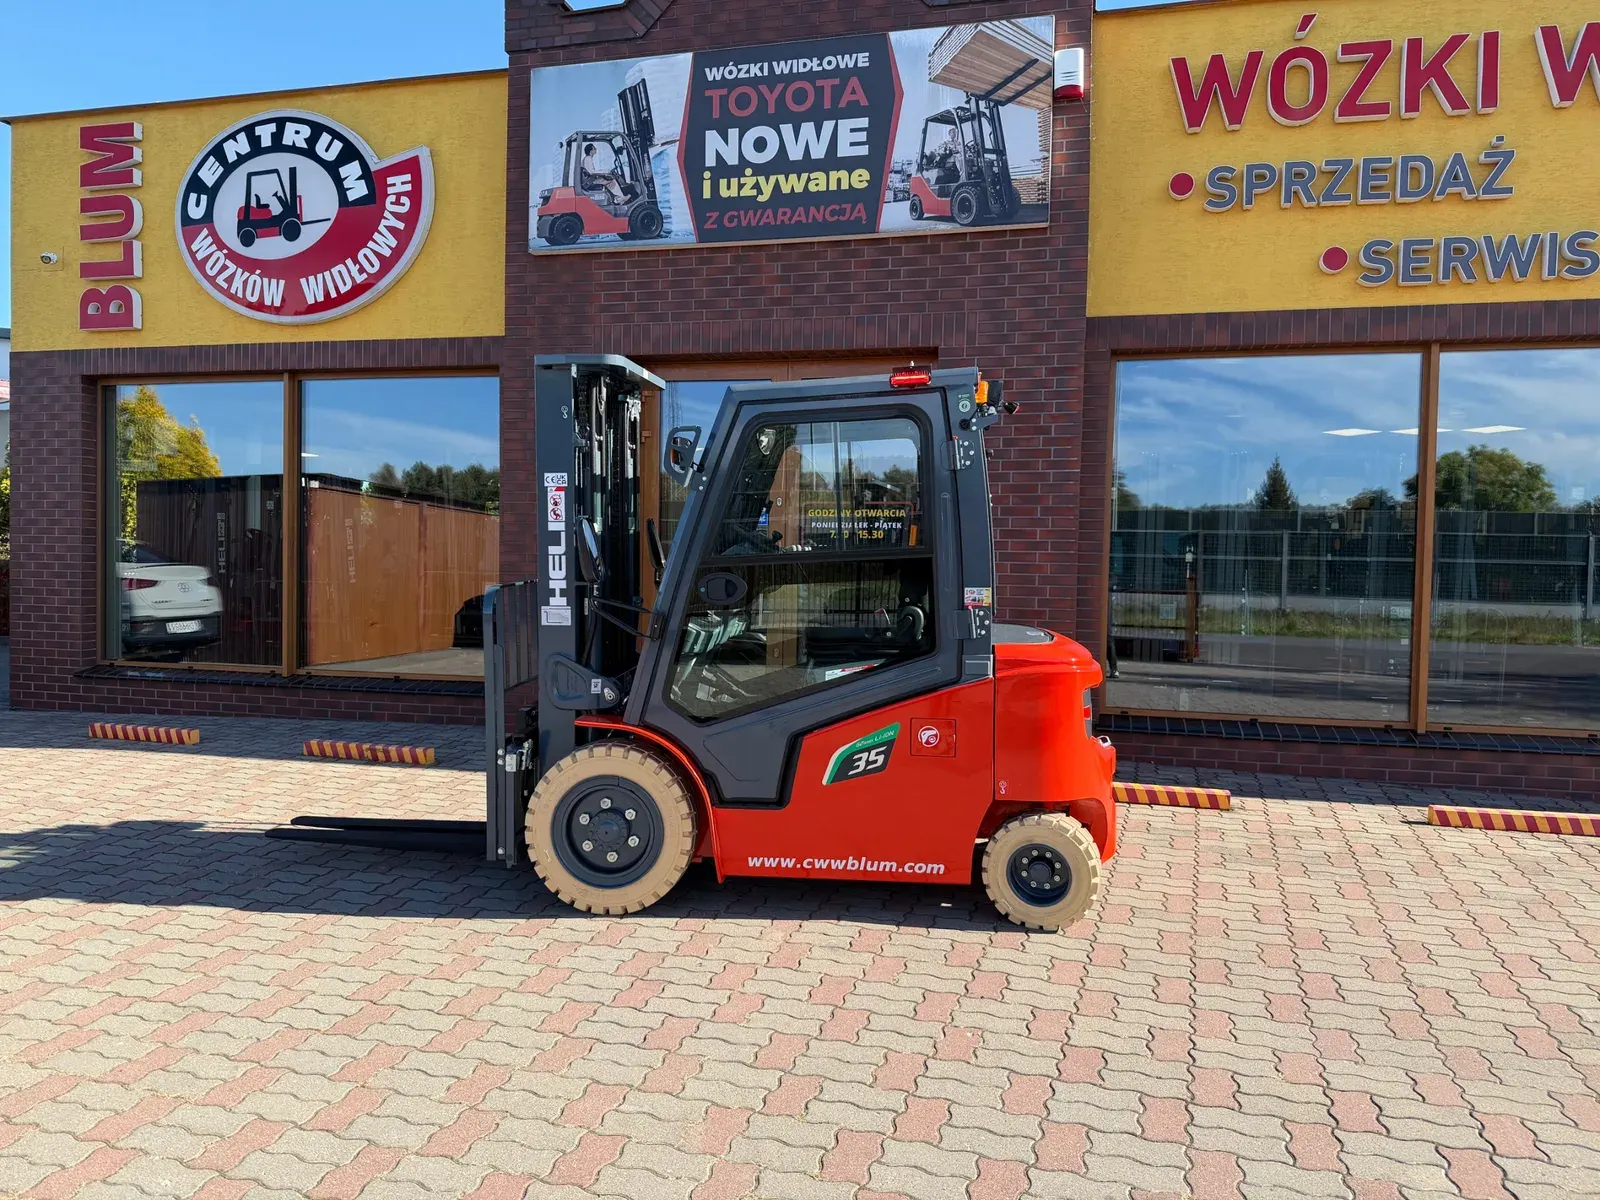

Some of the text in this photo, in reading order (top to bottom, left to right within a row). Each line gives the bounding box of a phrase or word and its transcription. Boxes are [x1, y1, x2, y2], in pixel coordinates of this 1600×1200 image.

[704, 52, 870, 82] WÓZKI WIDŁOWE
[1169, 13, 1501, 134] WÓZKI
[704, 77, 869, 118] TOYOTA
[704, 117, 870, 167] NOWE
[187, 121, 369, 220] CENTRUM
[702, 167, 870, 204] i używane
[1203, 135, 1516, 213] SPRZEDAŻ
[79, 121, 143, 331] BLUM
[704, 202, 867, 229] Z GWARANCJĄ
[190, 172, 413, 307] WÓZKÓW WIDŁOWYCH
[1356, 229, 1600, 288] SERWIS
[854, 509, 907, 518] OTWARCIA
[858, 530, 884, 539] 15.30
[548, 521, 567, 606] HELI
[847, 745, 888, 776] 35
[747, 856, 946, 875] www.cwwblum.com
